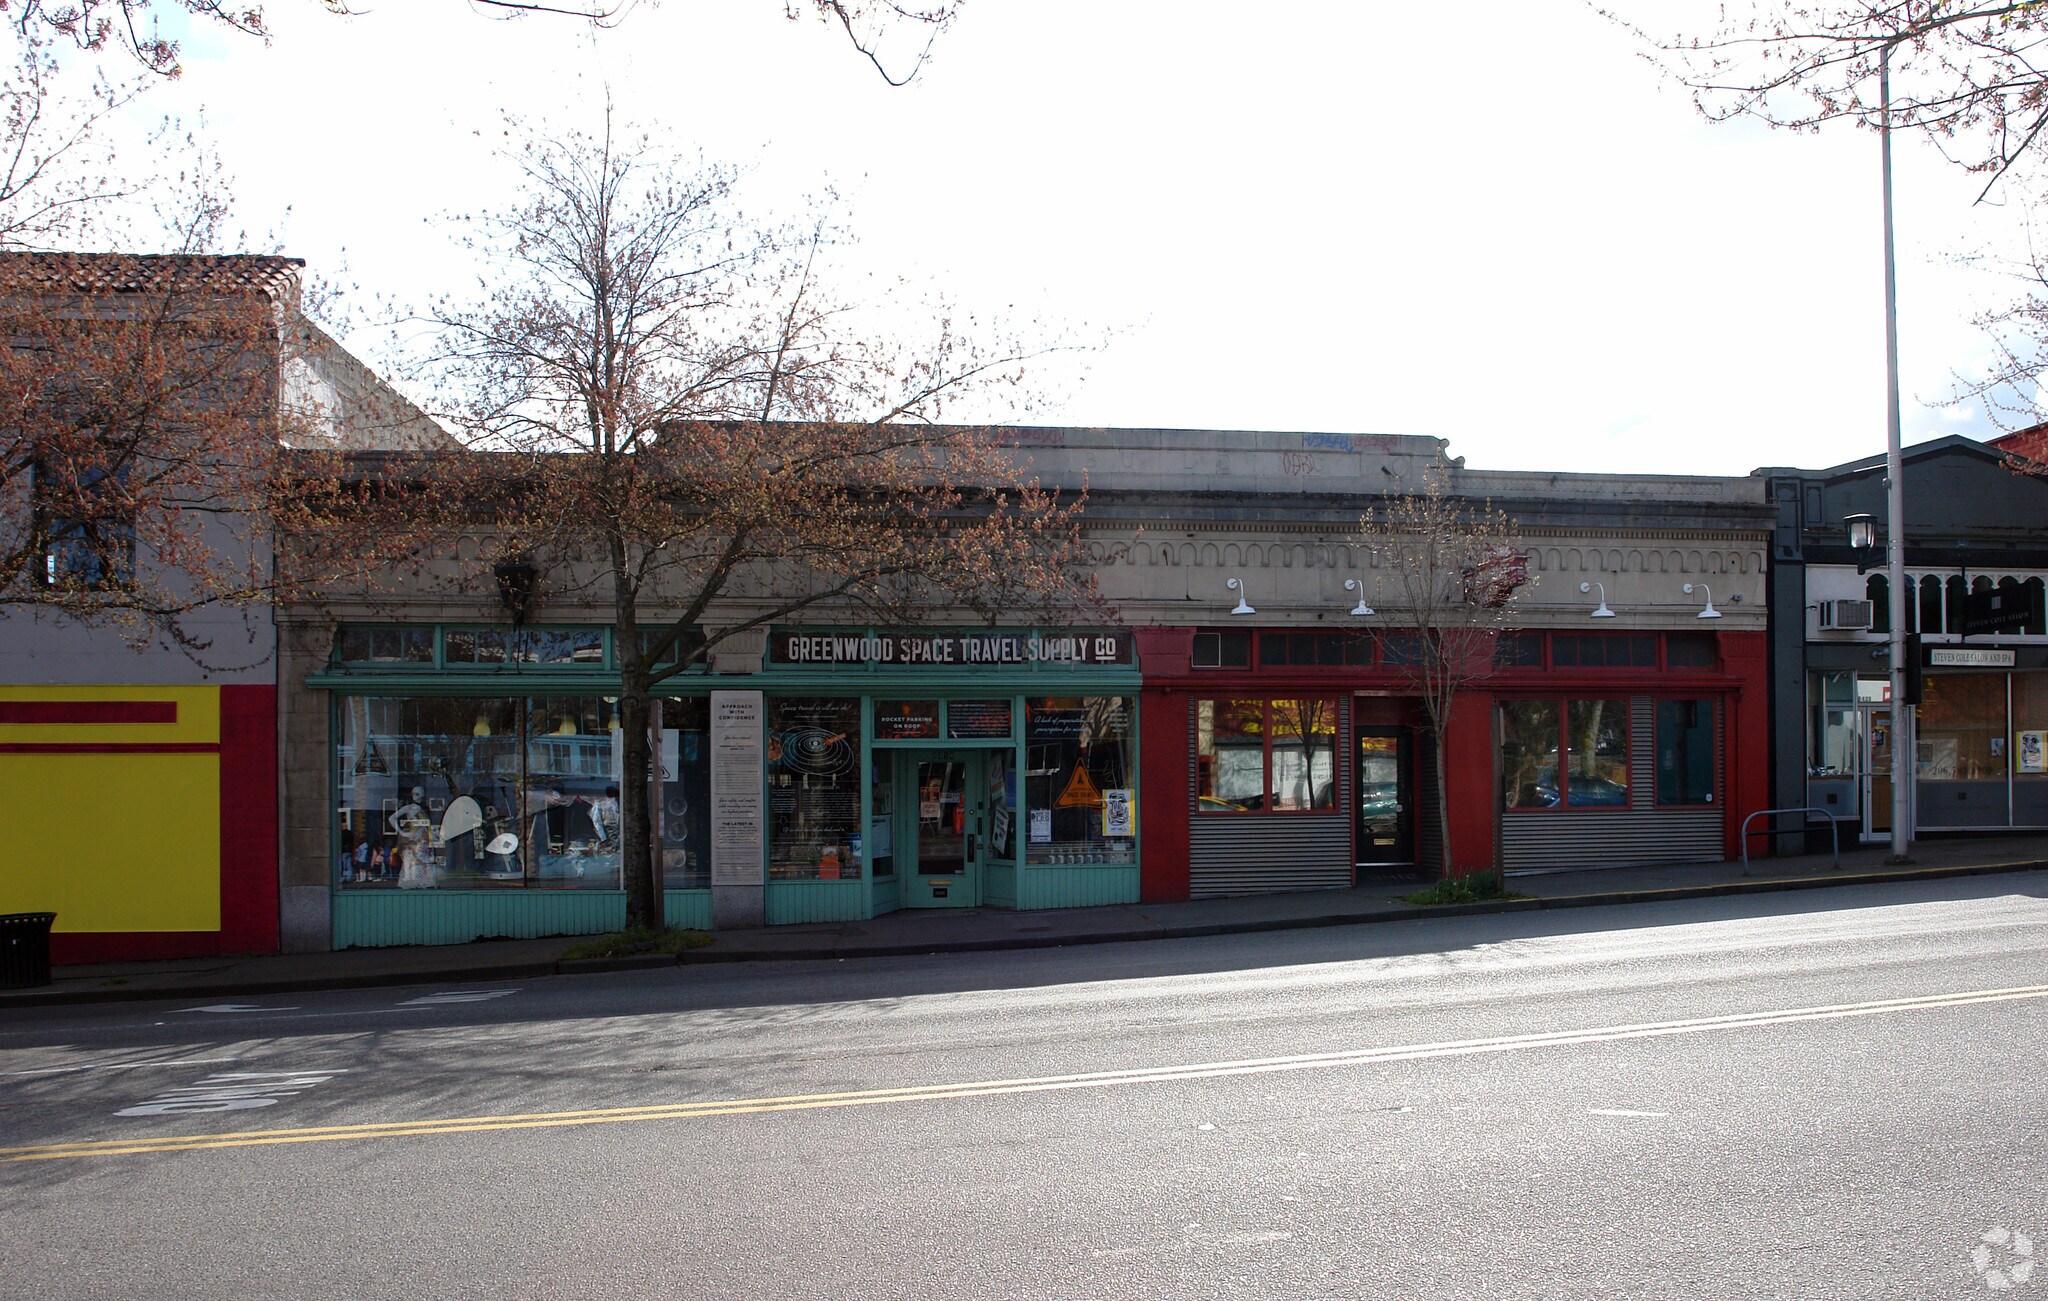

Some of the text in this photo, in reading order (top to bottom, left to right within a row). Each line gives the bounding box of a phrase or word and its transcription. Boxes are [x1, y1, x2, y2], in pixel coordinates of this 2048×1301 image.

[1966, 610, 2030, 629] STEVEN COLE SALON
[788, 636, 1117, 662] GREENWOOD SPACE TRAVEL SUPPLY CO
[1934, 652, 2011, 662] STEVEN COLE SALON AND SPA
